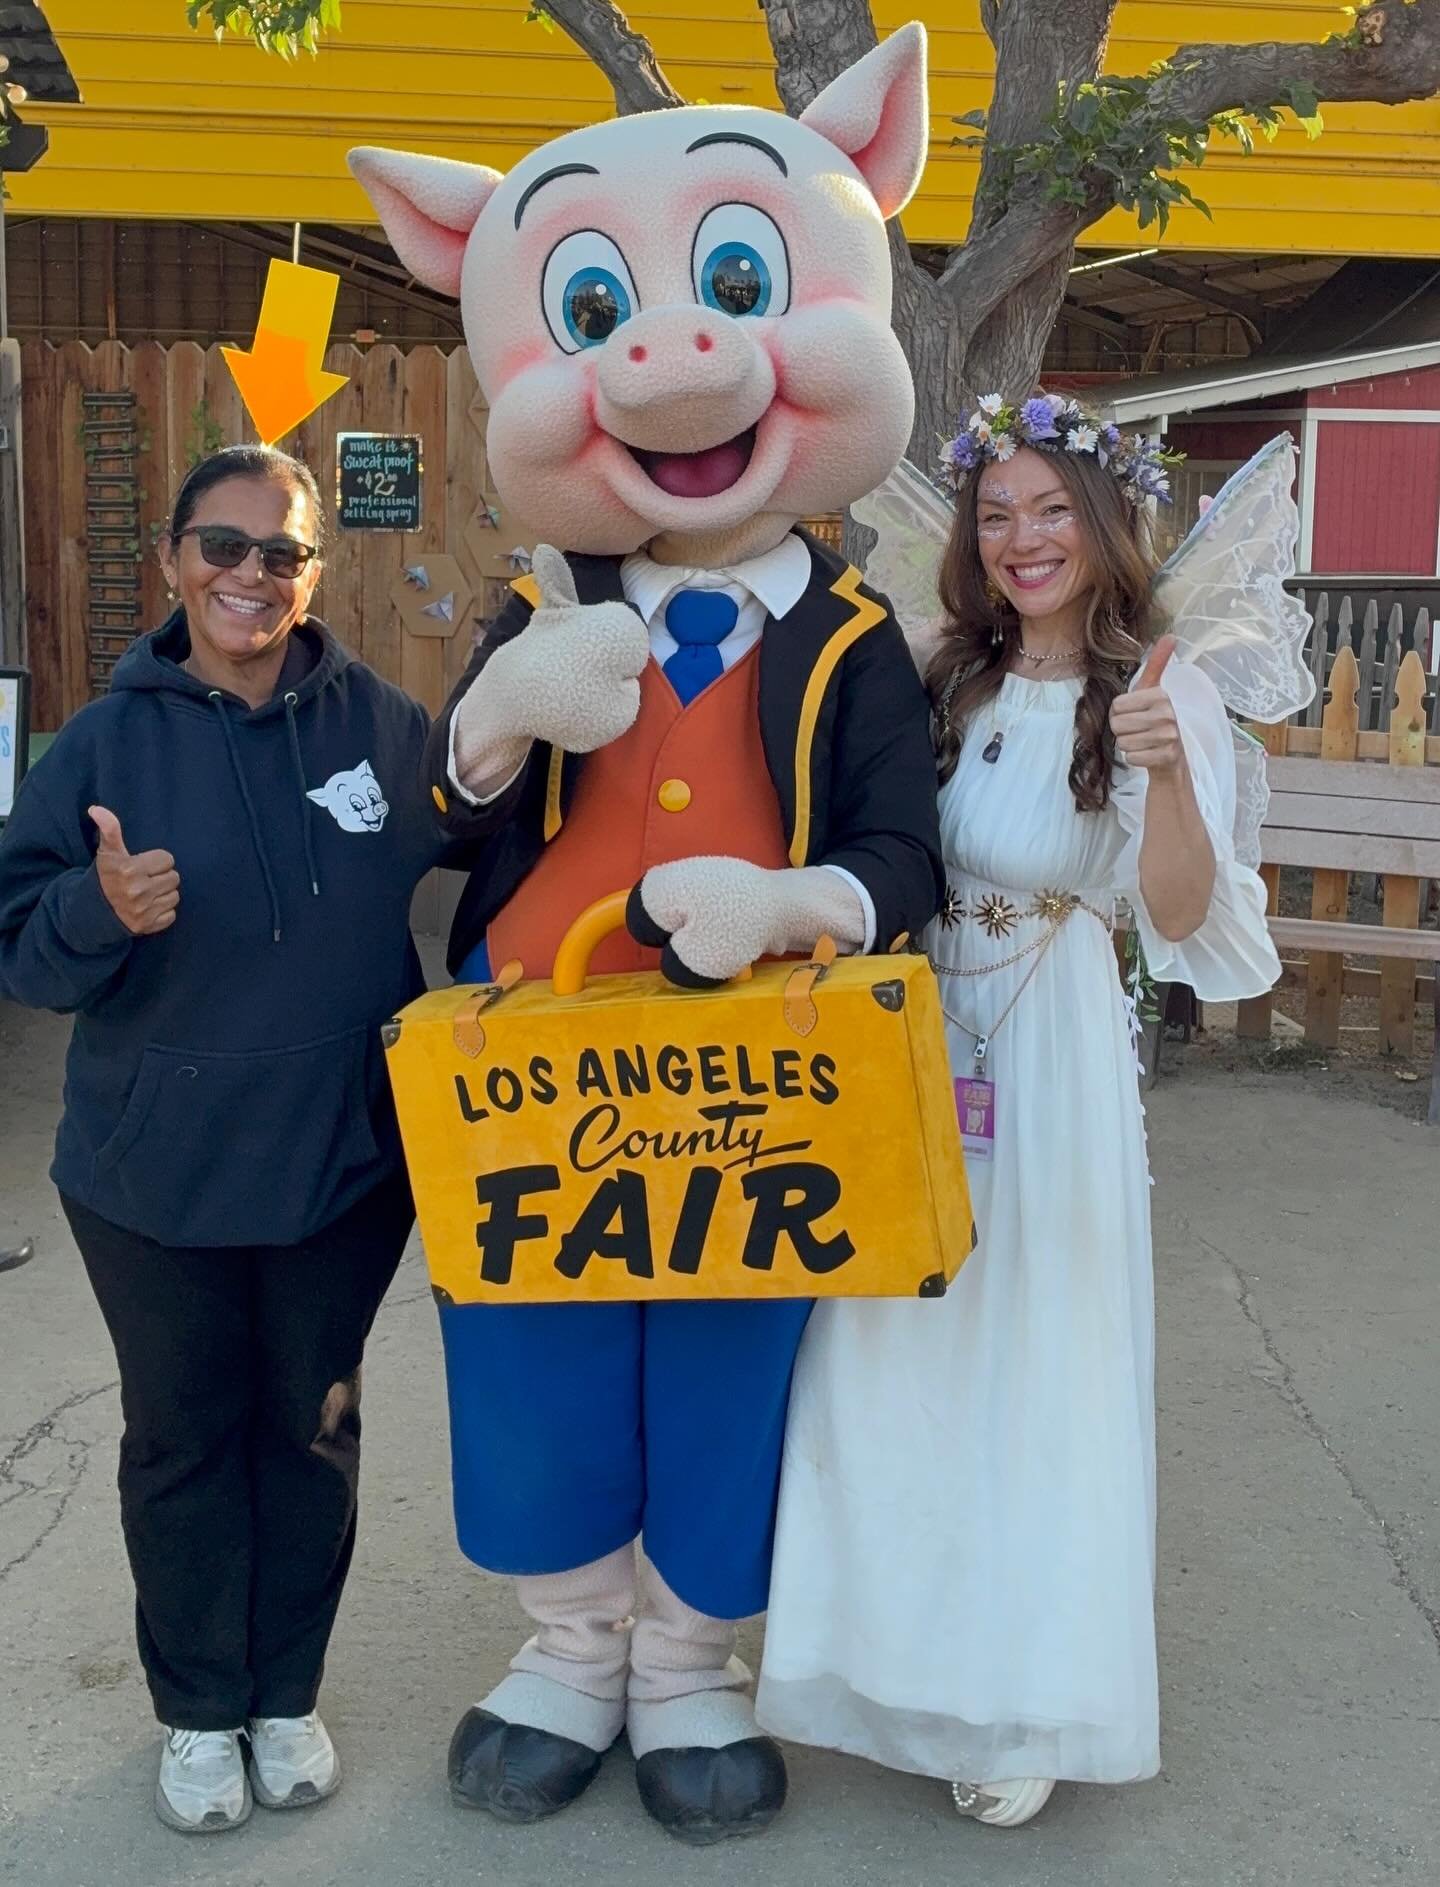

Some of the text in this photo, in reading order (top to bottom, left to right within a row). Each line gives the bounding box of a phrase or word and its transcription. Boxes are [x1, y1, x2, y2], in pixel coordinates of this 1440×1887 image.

[349, 440, 399, 454] make it
[384, 453, 415, 475] proof
[348, 494, 416, 507] professional
[343, 507, 412, 524] setting spray
[454, 1044, 840, 1124] LOS ANGELES
[568, 1100, 812, 1173] County
[476, 1161, 856, 1285] FAIR
